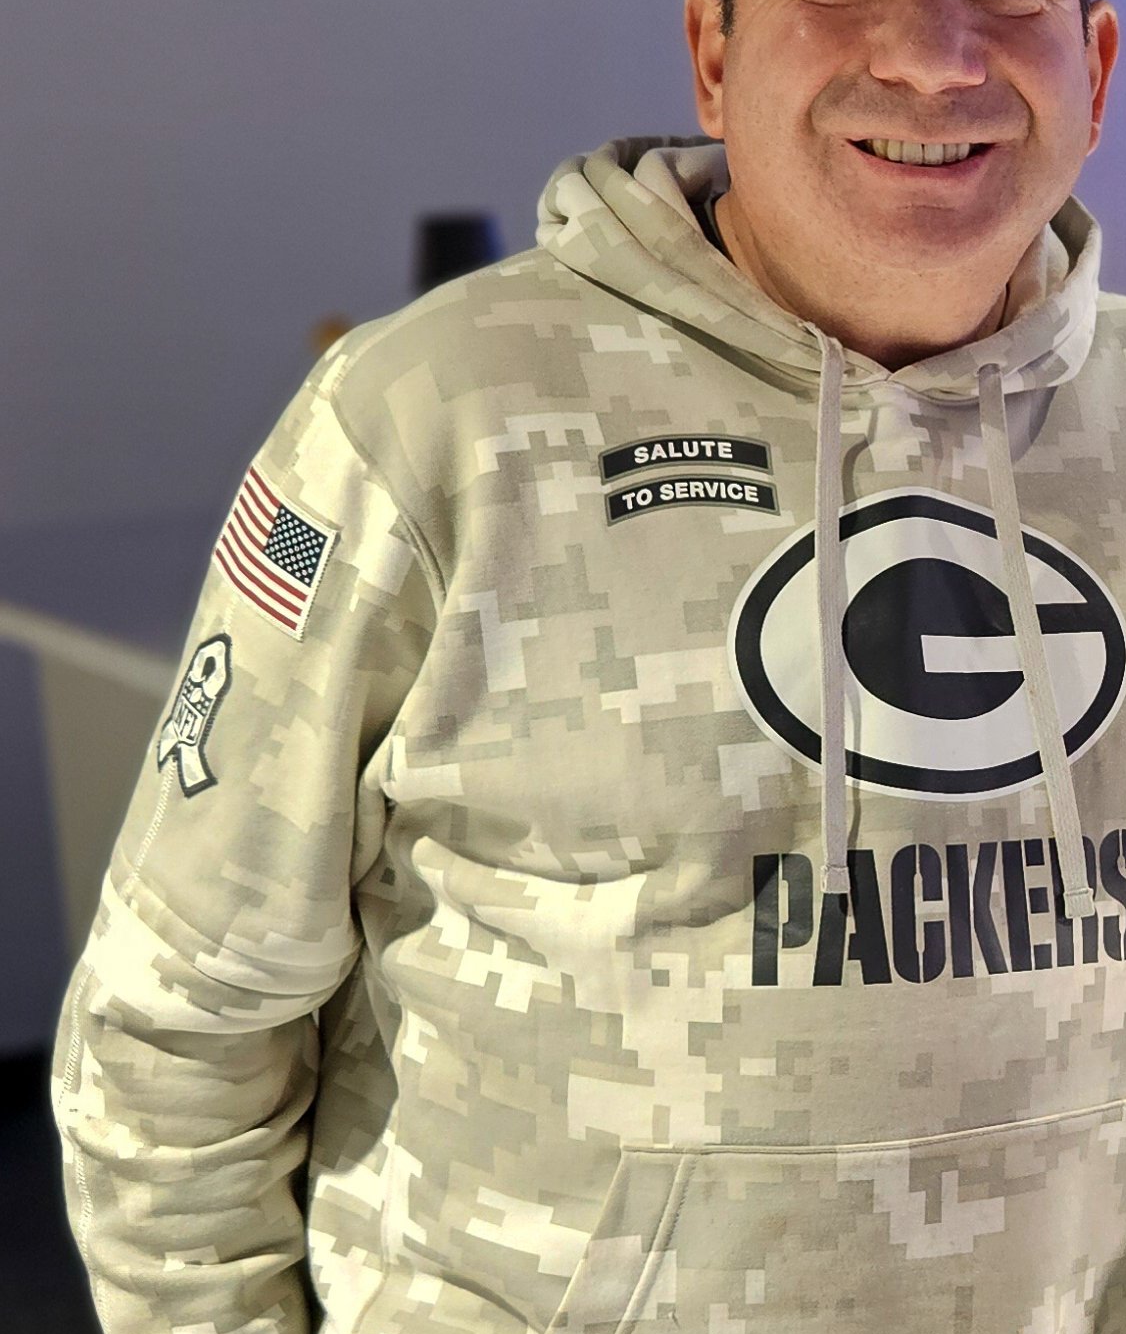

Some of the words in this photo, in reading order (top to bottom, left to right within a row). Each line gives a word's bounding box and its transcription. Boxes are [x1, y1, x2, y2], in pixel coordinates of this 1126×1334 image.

[634, 441, 733, 464] SALUTE
[622, 488, 653, 510] TO
[659, 481, 760, 503] SERVICE
